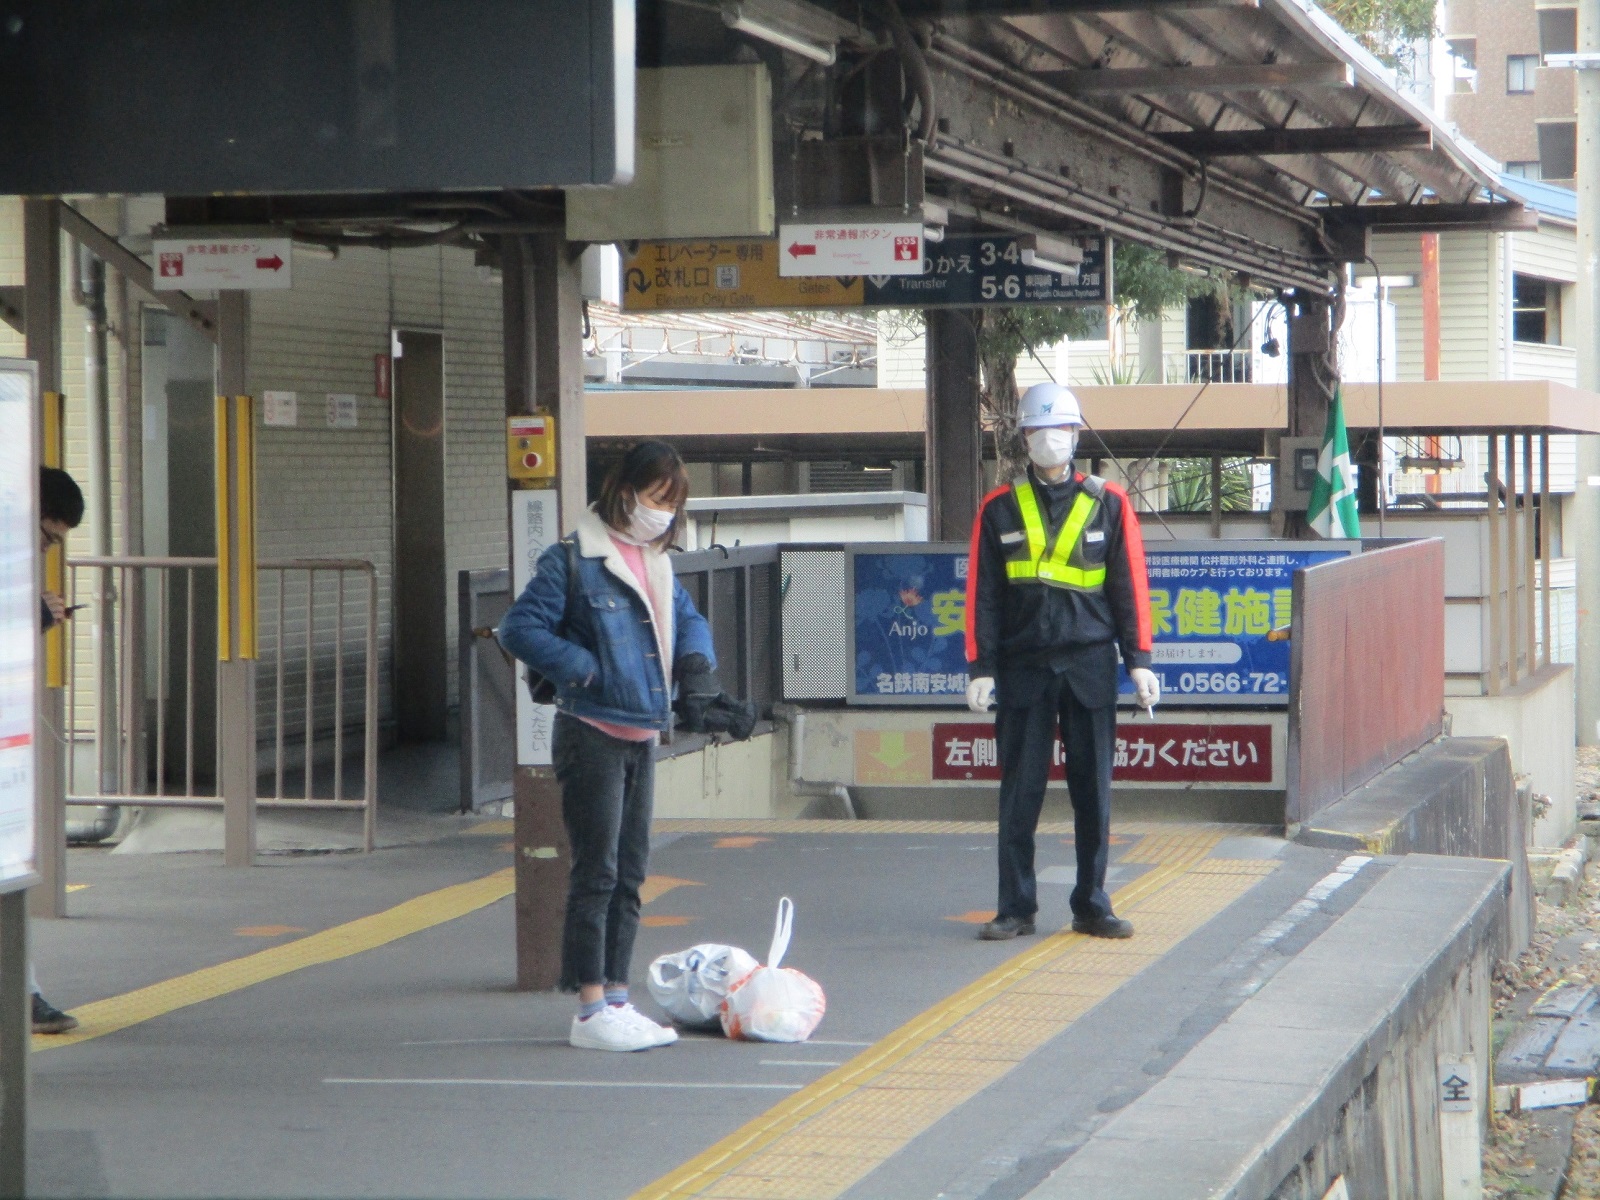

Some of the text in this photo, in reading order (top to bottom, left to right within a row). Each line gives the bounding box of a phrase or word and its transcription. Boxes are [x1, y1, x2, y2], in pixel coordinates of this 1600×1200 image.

[815, 229, 892, 240] 非常通報ボタン
[654, 244, 731, 262] エレベーター
[655, 266, 710, 288] 改札口
[900, 279, 948, 290] Transfer
[799, 282, 831, 294] Gates
[888, 621, 929, 641] Anjo
[876, 672, 971, 693] 名鉄南安城
[1442, 1074, 1470, 1101] 全
